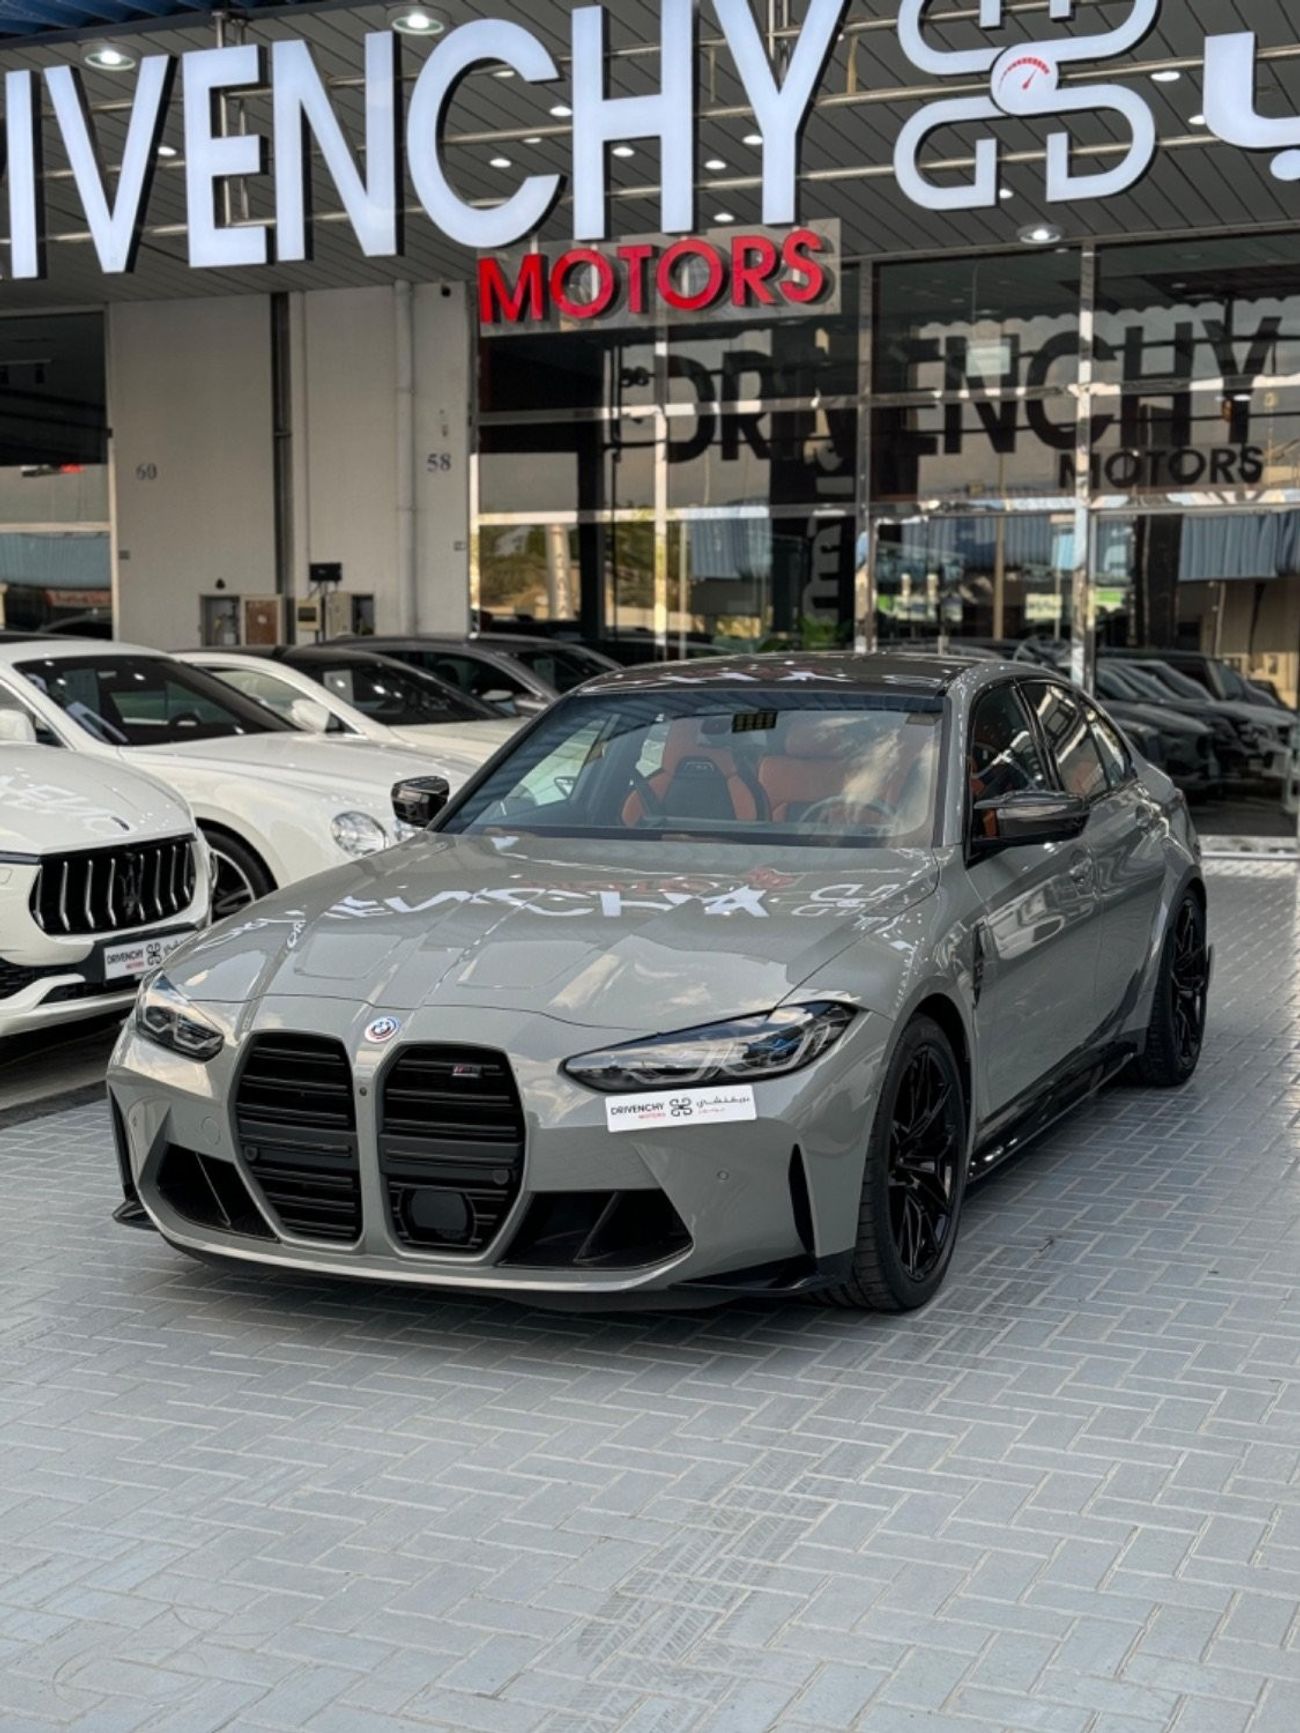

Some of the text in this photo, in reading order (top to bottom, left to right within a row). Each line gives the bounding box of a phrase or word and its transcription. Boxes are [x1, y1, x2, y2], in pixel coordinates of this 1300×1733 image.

[478, 229, 825, 325] MOTORS
[136, 462, 157, 480] 60
[428, 452, 451, 472] 58
[1059, 446, 1264, 489] MOTORS
[611, 1102, 665, 1115] DRIVENCHY
